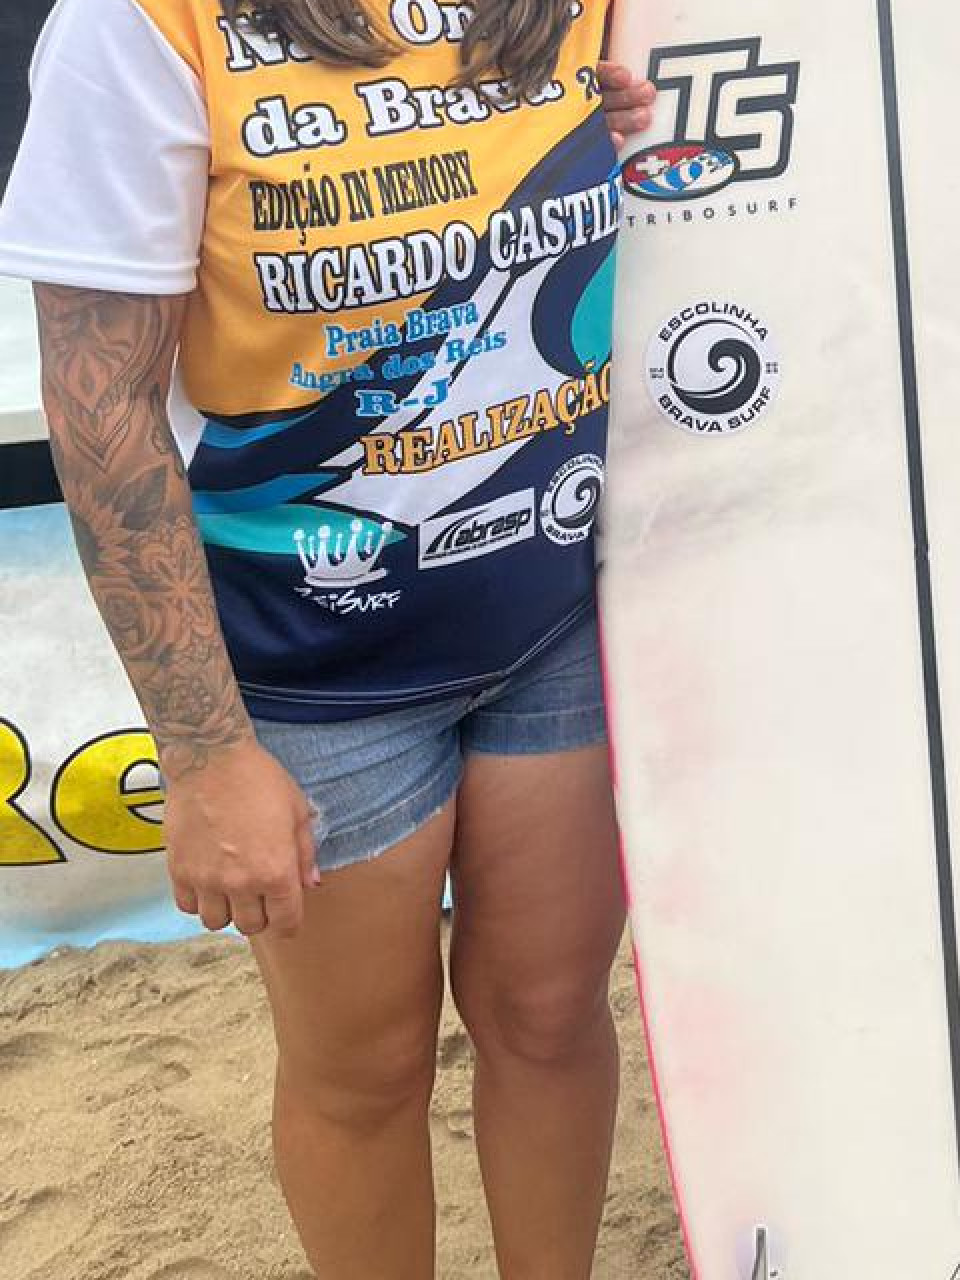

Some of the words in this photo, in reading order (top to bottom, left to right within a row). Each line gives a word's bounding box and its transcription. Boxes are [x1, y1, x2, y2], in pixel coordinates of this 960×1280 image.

[241, 95, 347, 158] da
[341, 170, 373, 220] IN
[372, 150, 478, 216] MEMORY
[254, 220, 477, 313] RICARDO
[324, 319, 401, 357] Praia
[404, 302, 479, 343] Brava
[445, 328, 508, 364] Reis
[658, 301, 768, 342] ESCOLINHA
[355, 377, 450, 417] R-J
[658, 394, 722, 433] BRAVA
[727, 386, 771, 429] SURF
